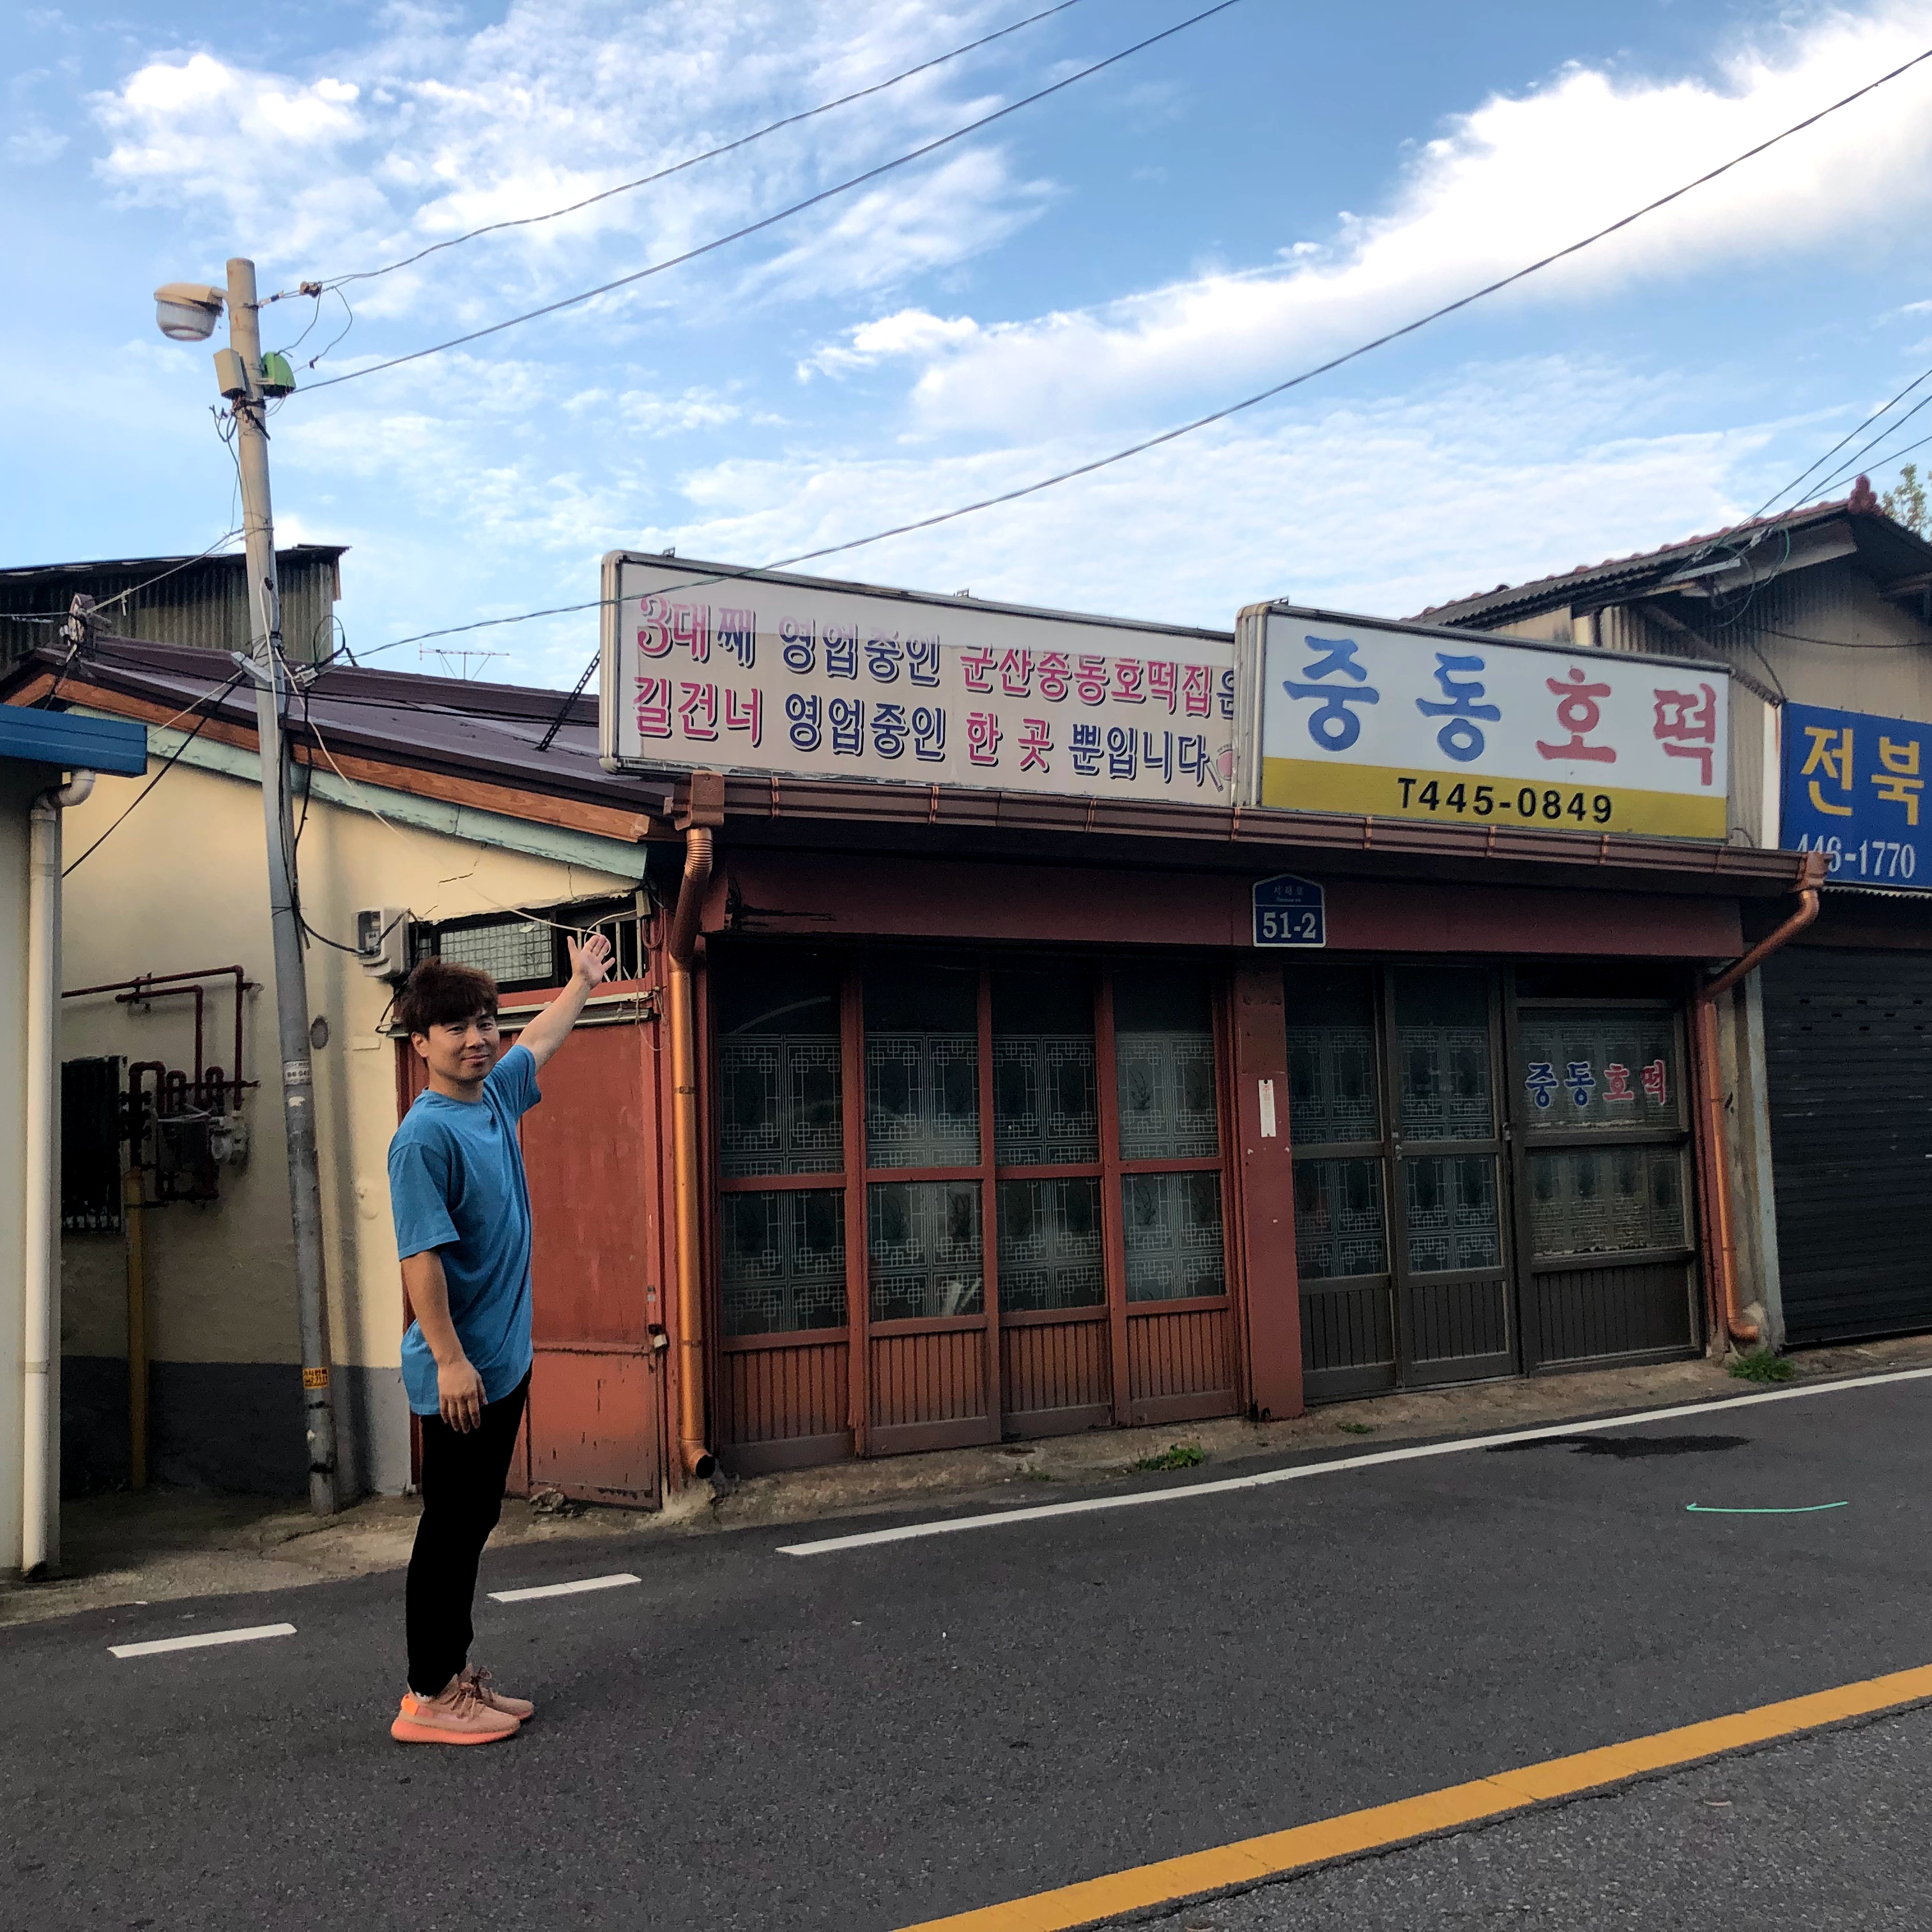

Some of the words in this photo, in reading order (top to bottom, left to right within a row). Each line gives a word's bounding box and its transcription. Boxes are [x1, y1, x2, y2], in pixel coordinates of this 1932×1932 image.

[638, 595, 756, 668] 3대째
[779, 615, 940, 687] 영업중인
[633, 677, 763, 747] 길건너
[785, 693, 946, 762] 영업중인
[965, 712, 1002, 767] 한
[1018, 717, 1054, 773] 곳
[1068, 723, 1210, 788] 뿐입니다
[1397, 777, 1612, 824] T445-0849
[1800, 726, 1924, 825] 전북
[1263, 912, 1316, 939] 51-2
[1524, 1059, 1666, 1109] 중동호떡
